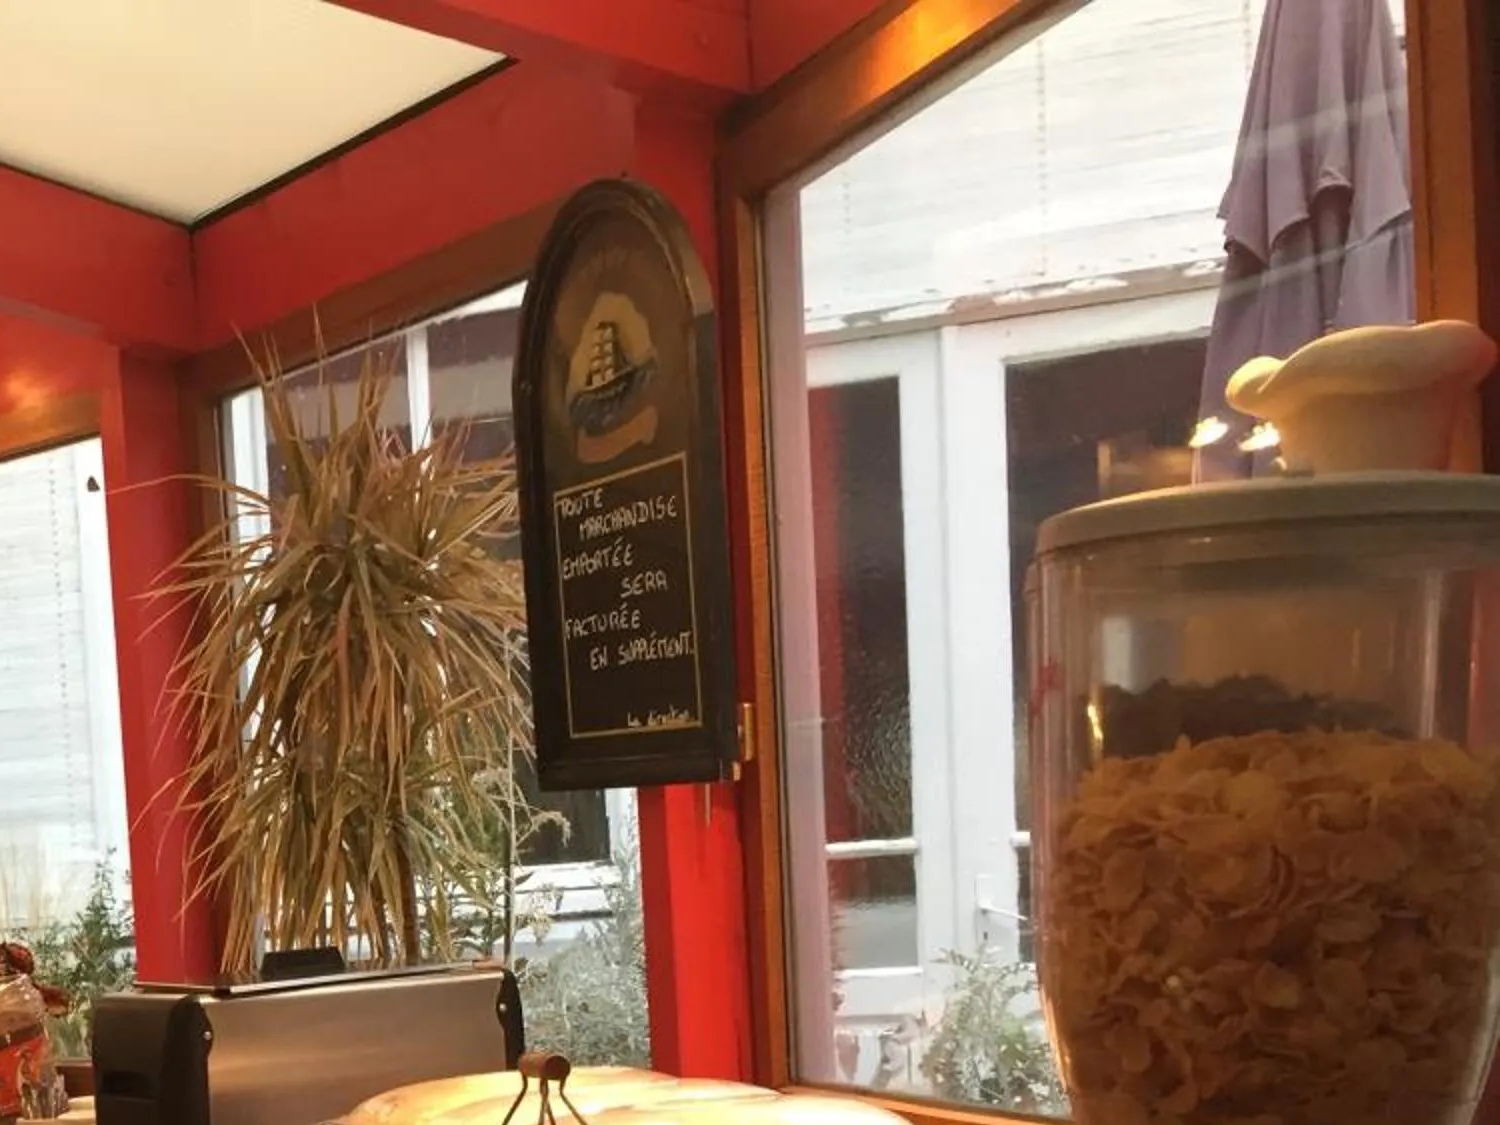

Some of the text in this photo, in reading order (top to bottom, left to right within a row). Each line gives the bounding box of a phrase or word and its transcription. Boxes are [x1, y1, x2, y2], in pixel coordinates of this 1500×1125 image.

[557, 488, 604, 519] TOUTE
[579, 495, 678, 541] MARCHANDISE
[563, 536, 634, 580] EMPORTÉE
[620, 569, 668, 598] SERA
[565, 602, 642, 640] FACTURÉE
[590, 644, 608, 671] EN
